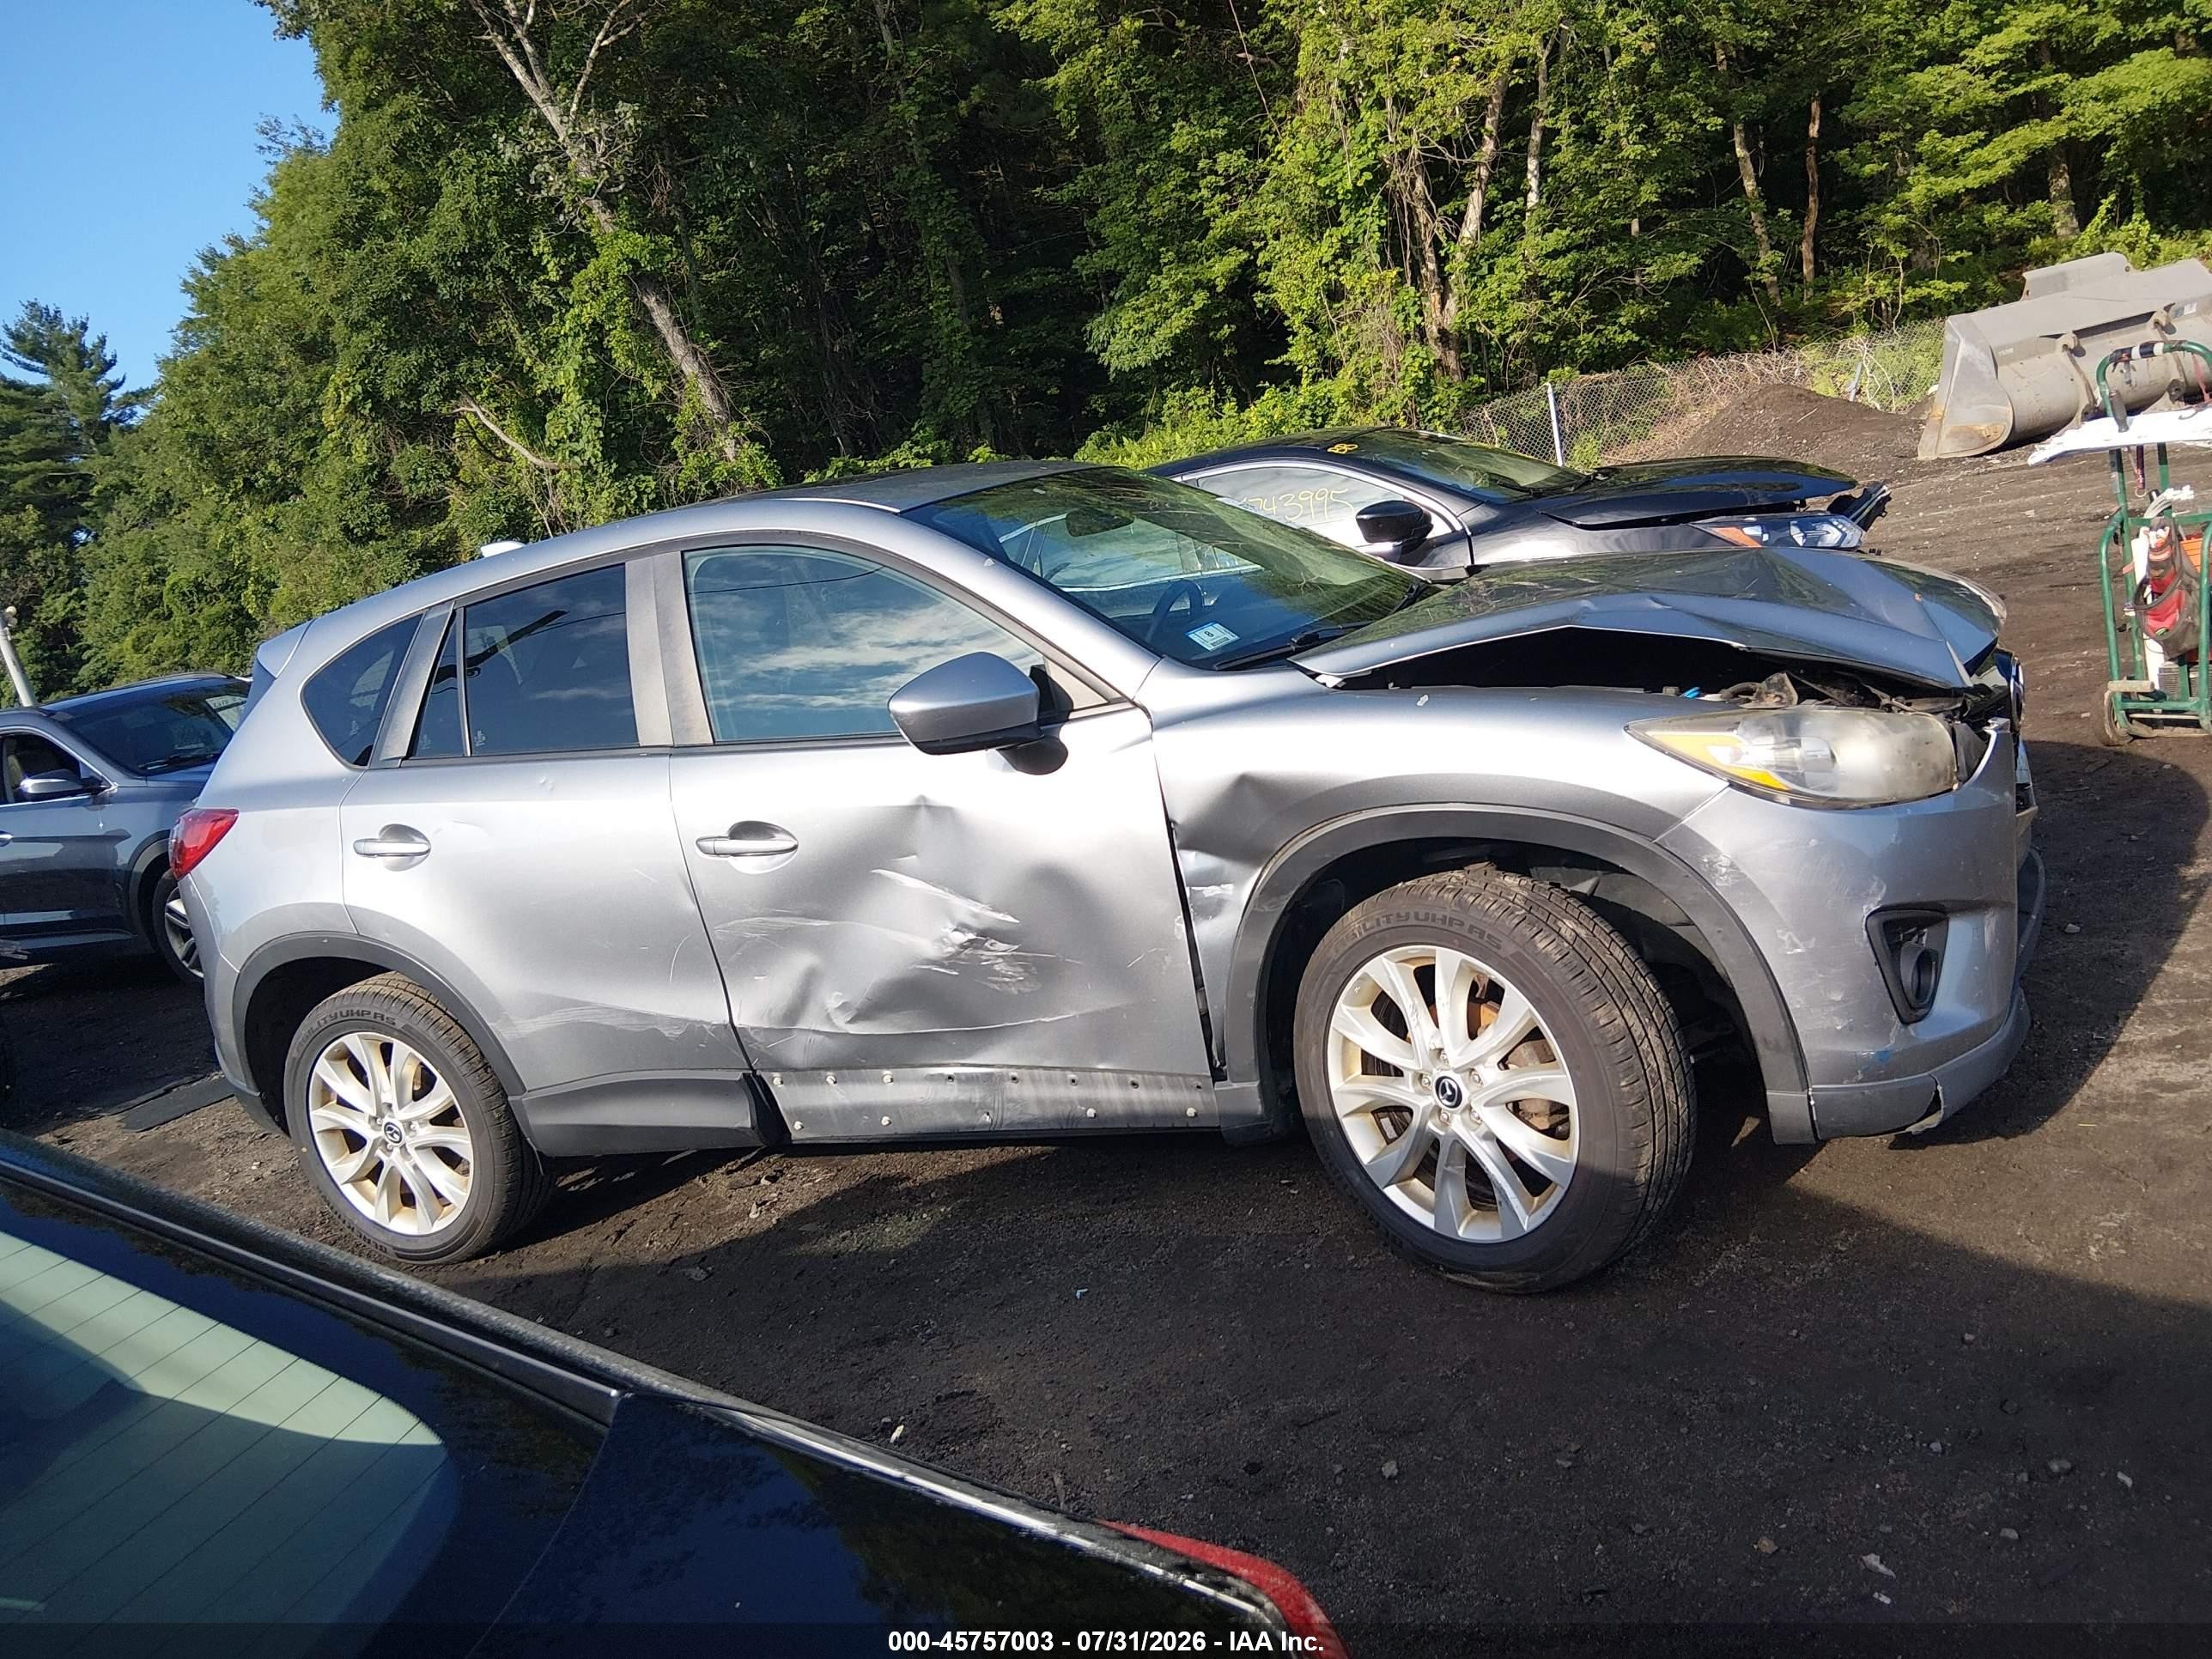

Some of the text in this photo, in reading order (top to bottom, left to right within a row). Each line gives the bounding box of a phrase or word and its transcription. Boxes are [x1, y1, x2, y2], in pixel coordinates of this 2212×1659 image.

[1413, 911, 1465, 927] UHP
[1468, 924, 1503, 950] AS
[340, 1009, 371, 1018] UHP
[374, 1012, 396, 1025] AS
